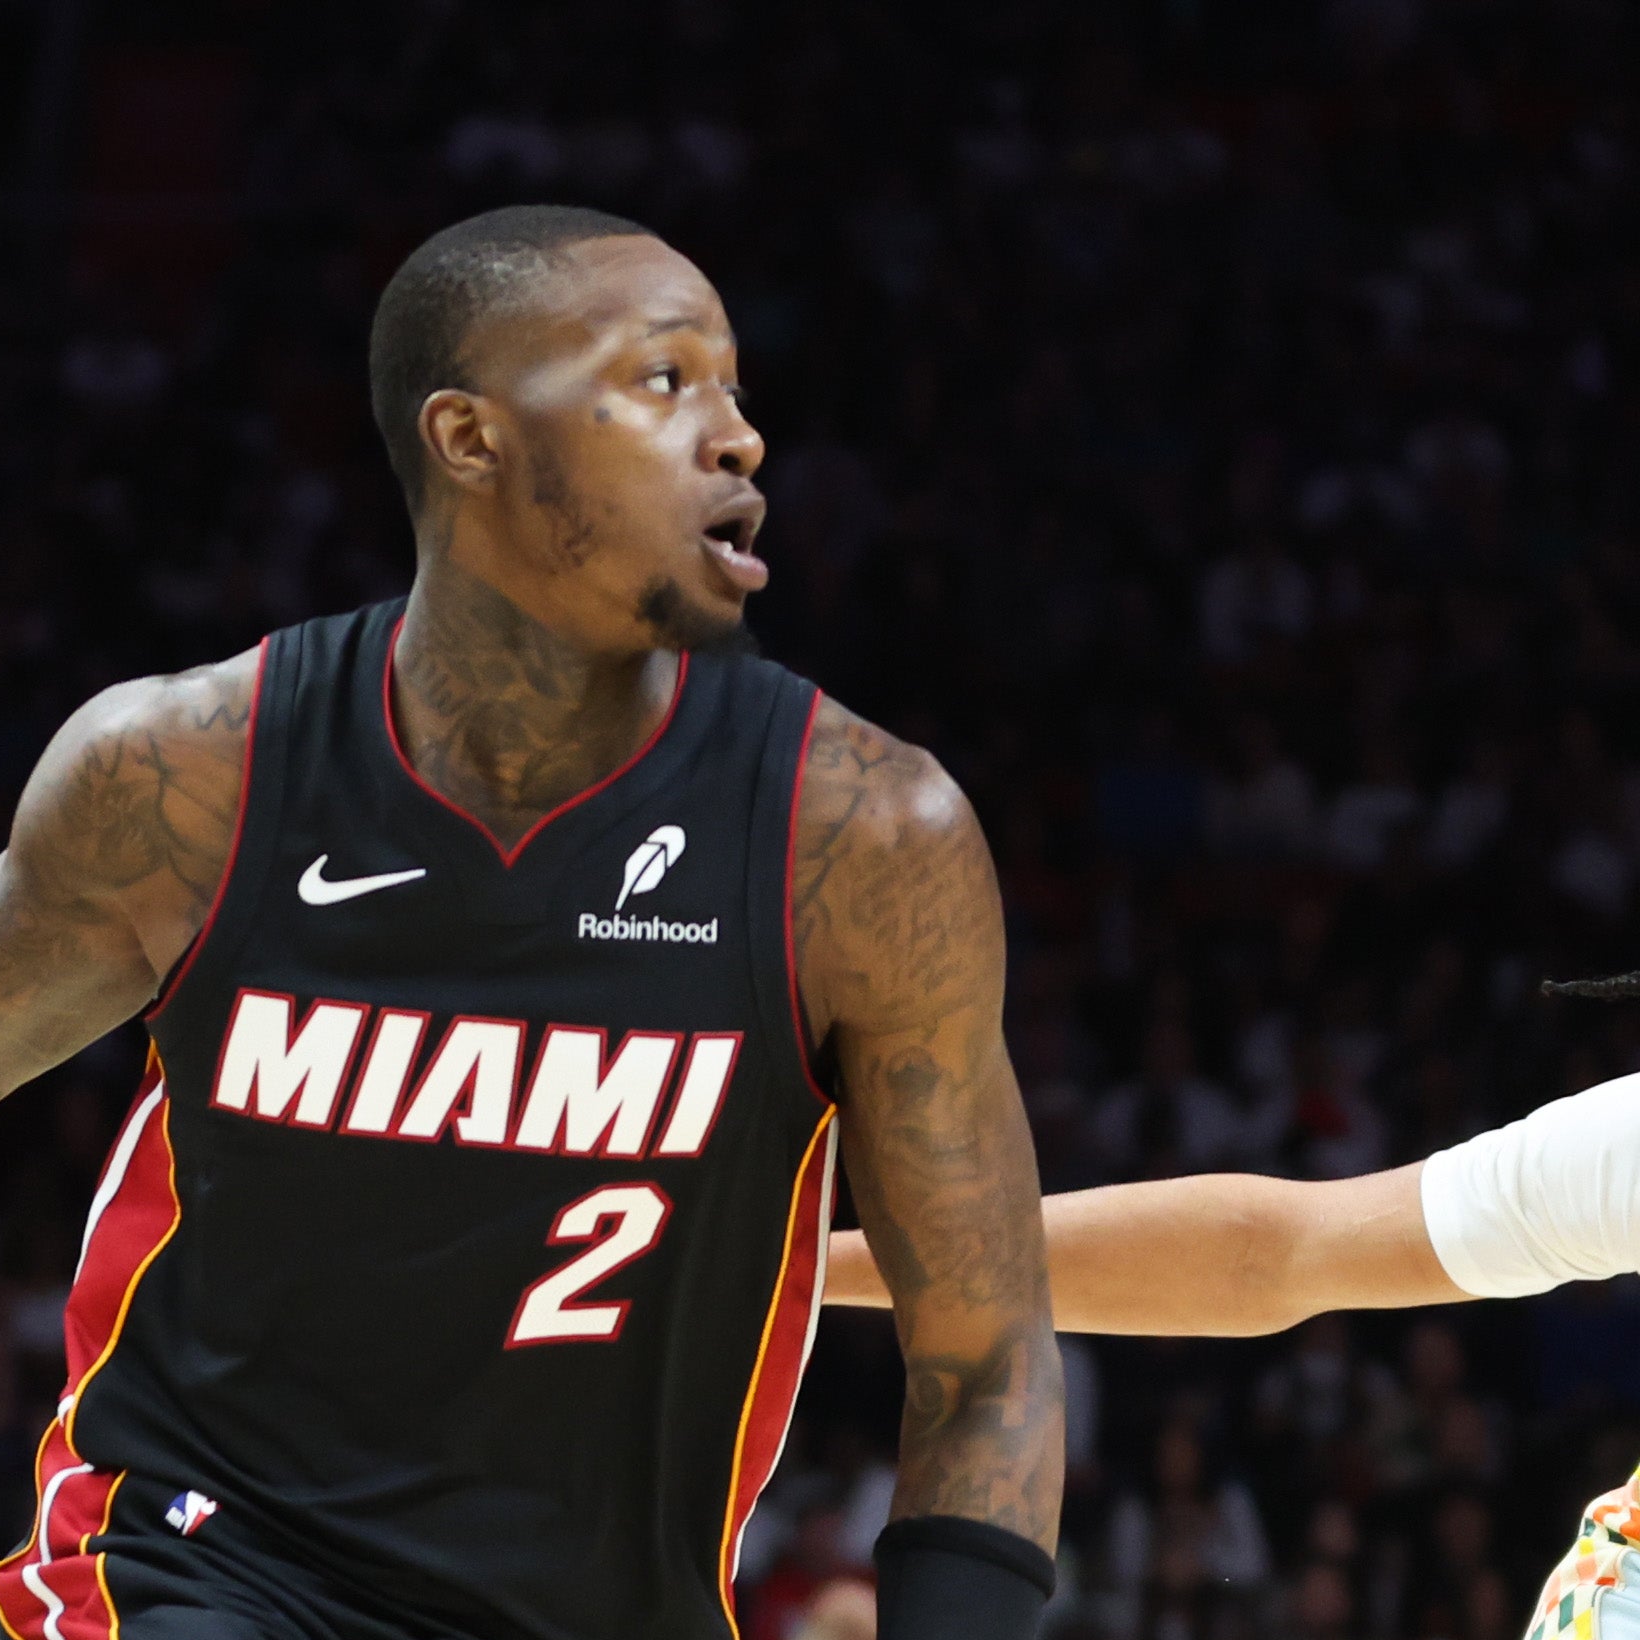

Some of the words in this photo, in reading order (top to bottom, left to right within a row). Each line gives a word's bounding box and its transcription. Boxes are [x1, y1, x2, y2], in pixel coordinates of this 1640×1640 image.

[578, 912, 719, 944] Robinhood
[208, 987, 743, 1160] MIAMI
[504, 1180, 674, 1350] 2
